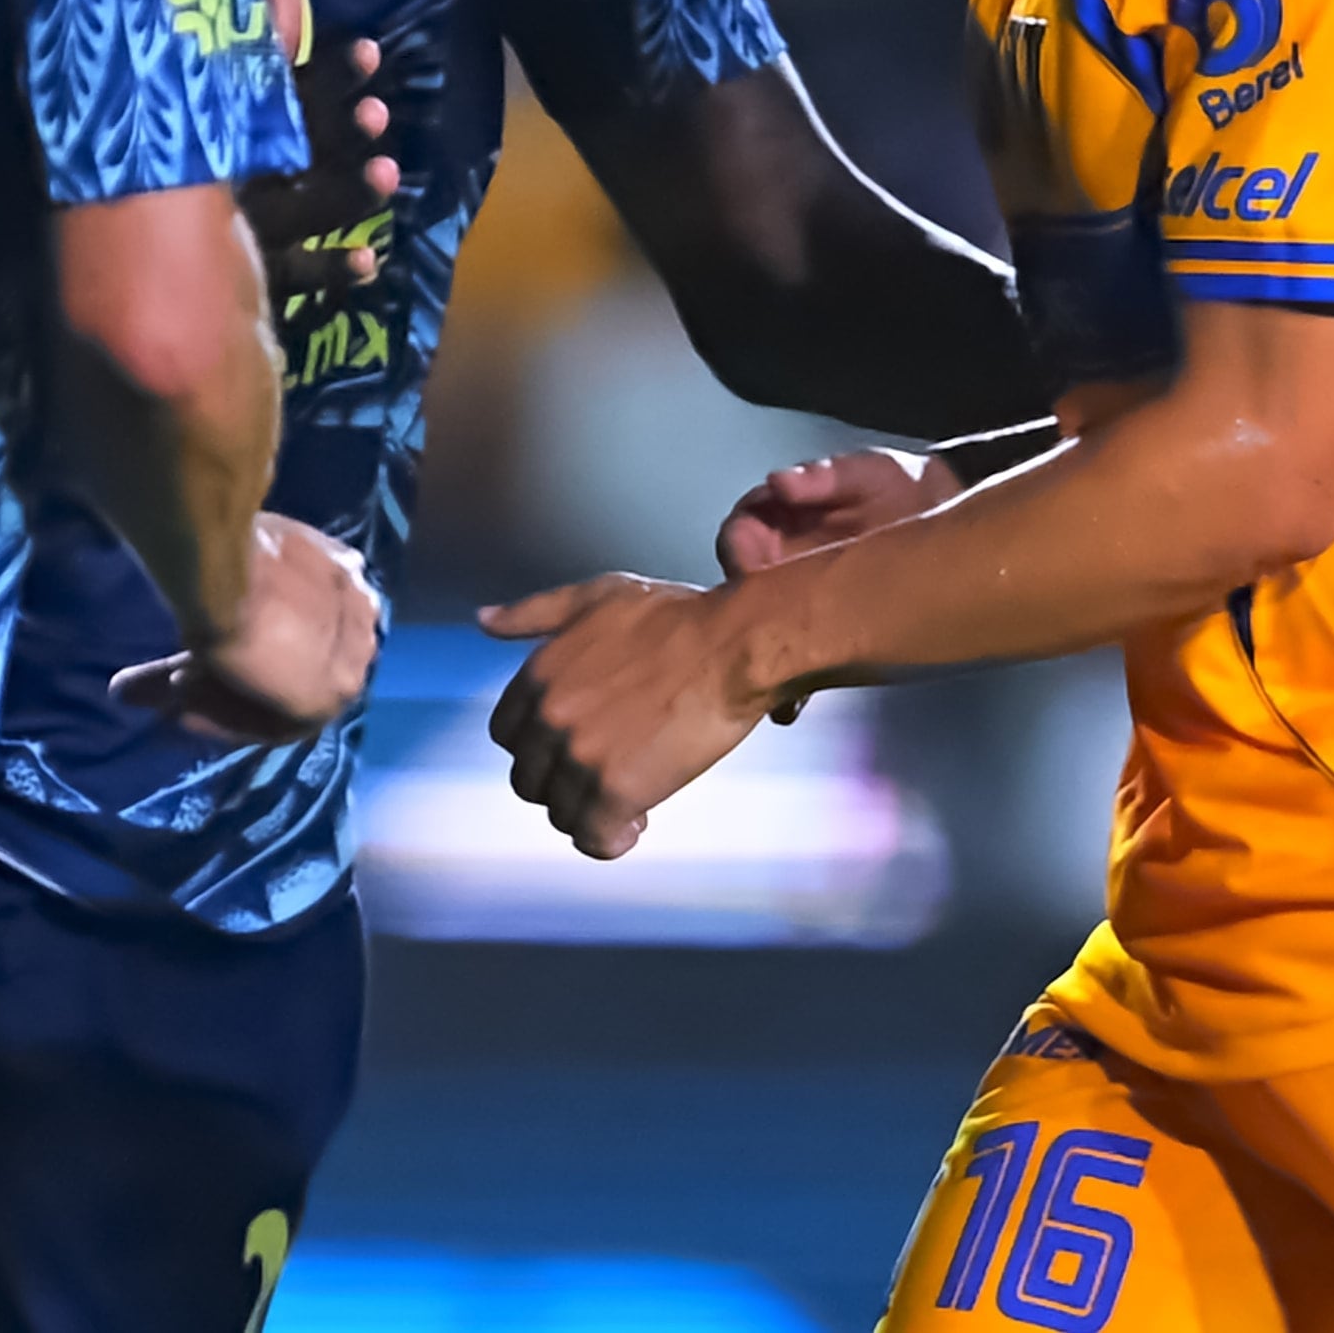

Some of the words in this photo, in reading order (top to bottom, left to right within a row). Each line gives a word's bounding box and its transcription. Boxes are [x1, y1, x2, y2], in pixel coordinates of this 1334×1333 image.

[1198, 42, 1304, 130] Berel
[1163, 151, 1319, 222] elcel
[934, 1121, 1152, 1333] 16
